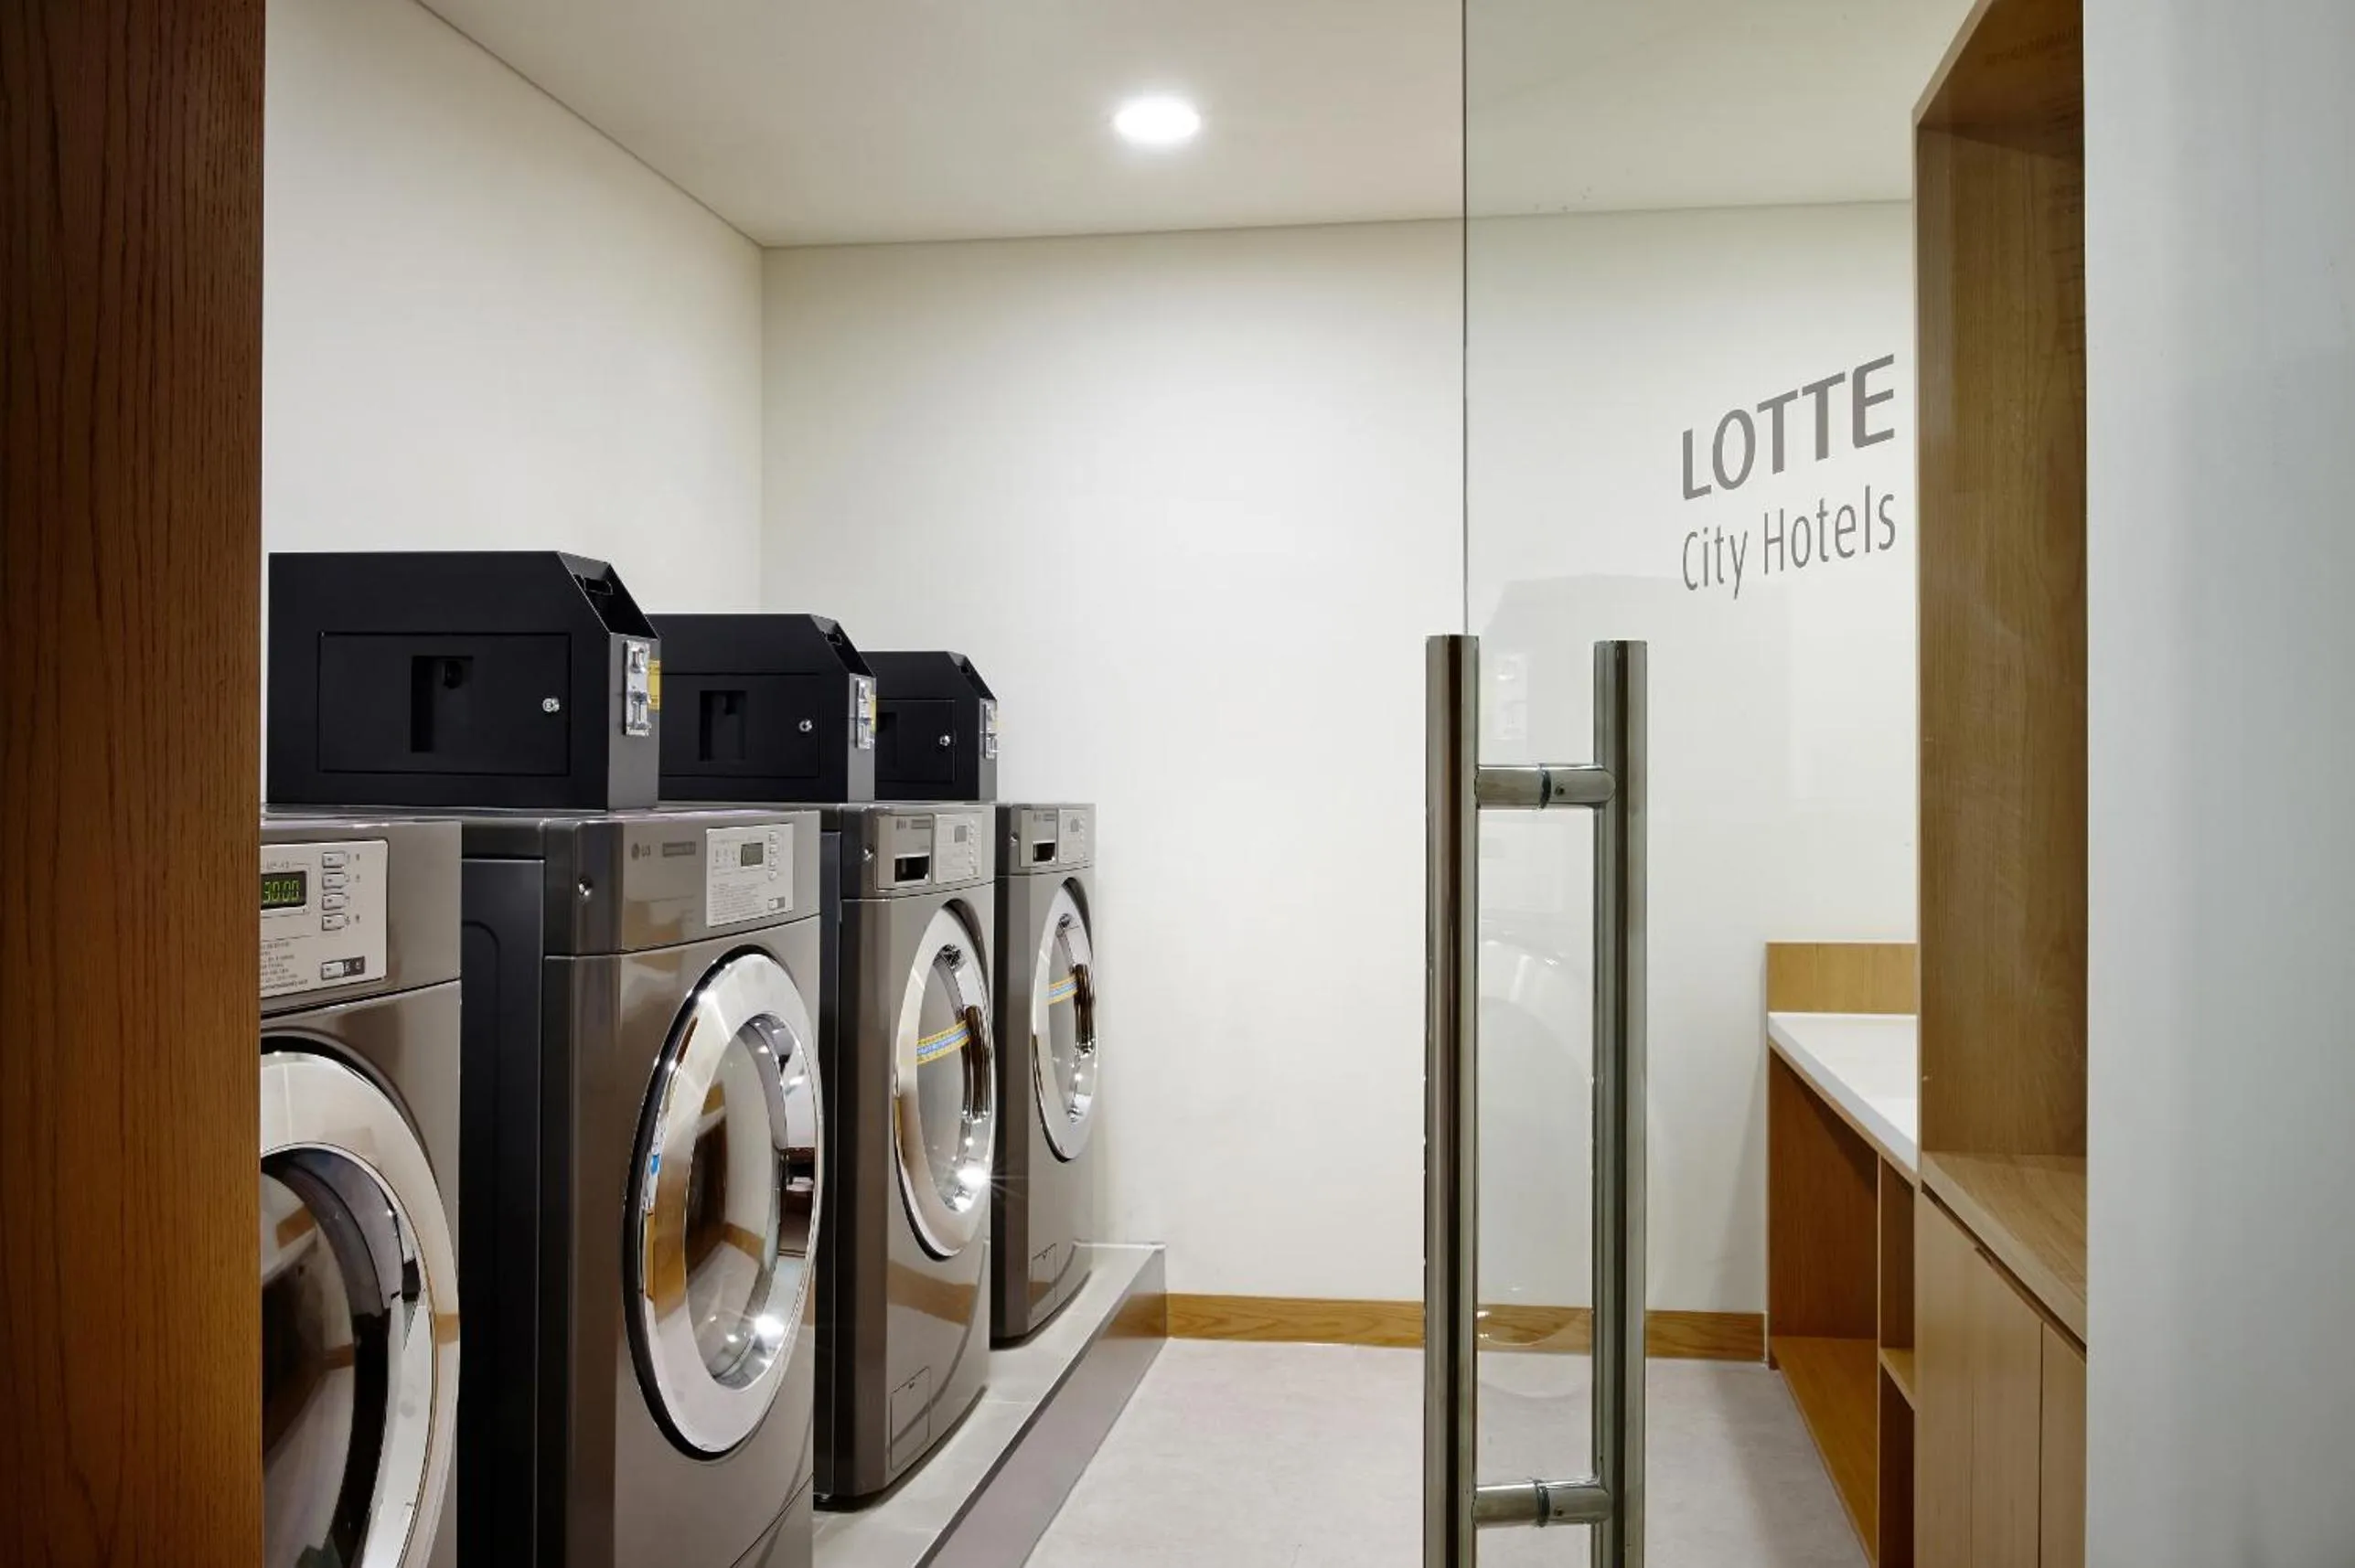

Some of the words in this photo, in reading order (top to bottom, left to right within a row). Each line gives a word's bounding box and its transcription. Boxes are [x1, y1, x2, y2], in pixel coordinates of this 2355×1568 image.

[1682, 353, 1895, 500] LOTTE
[1682, 525, 1748, 600] City
[1764, 485, 1896, 575] Hotels
